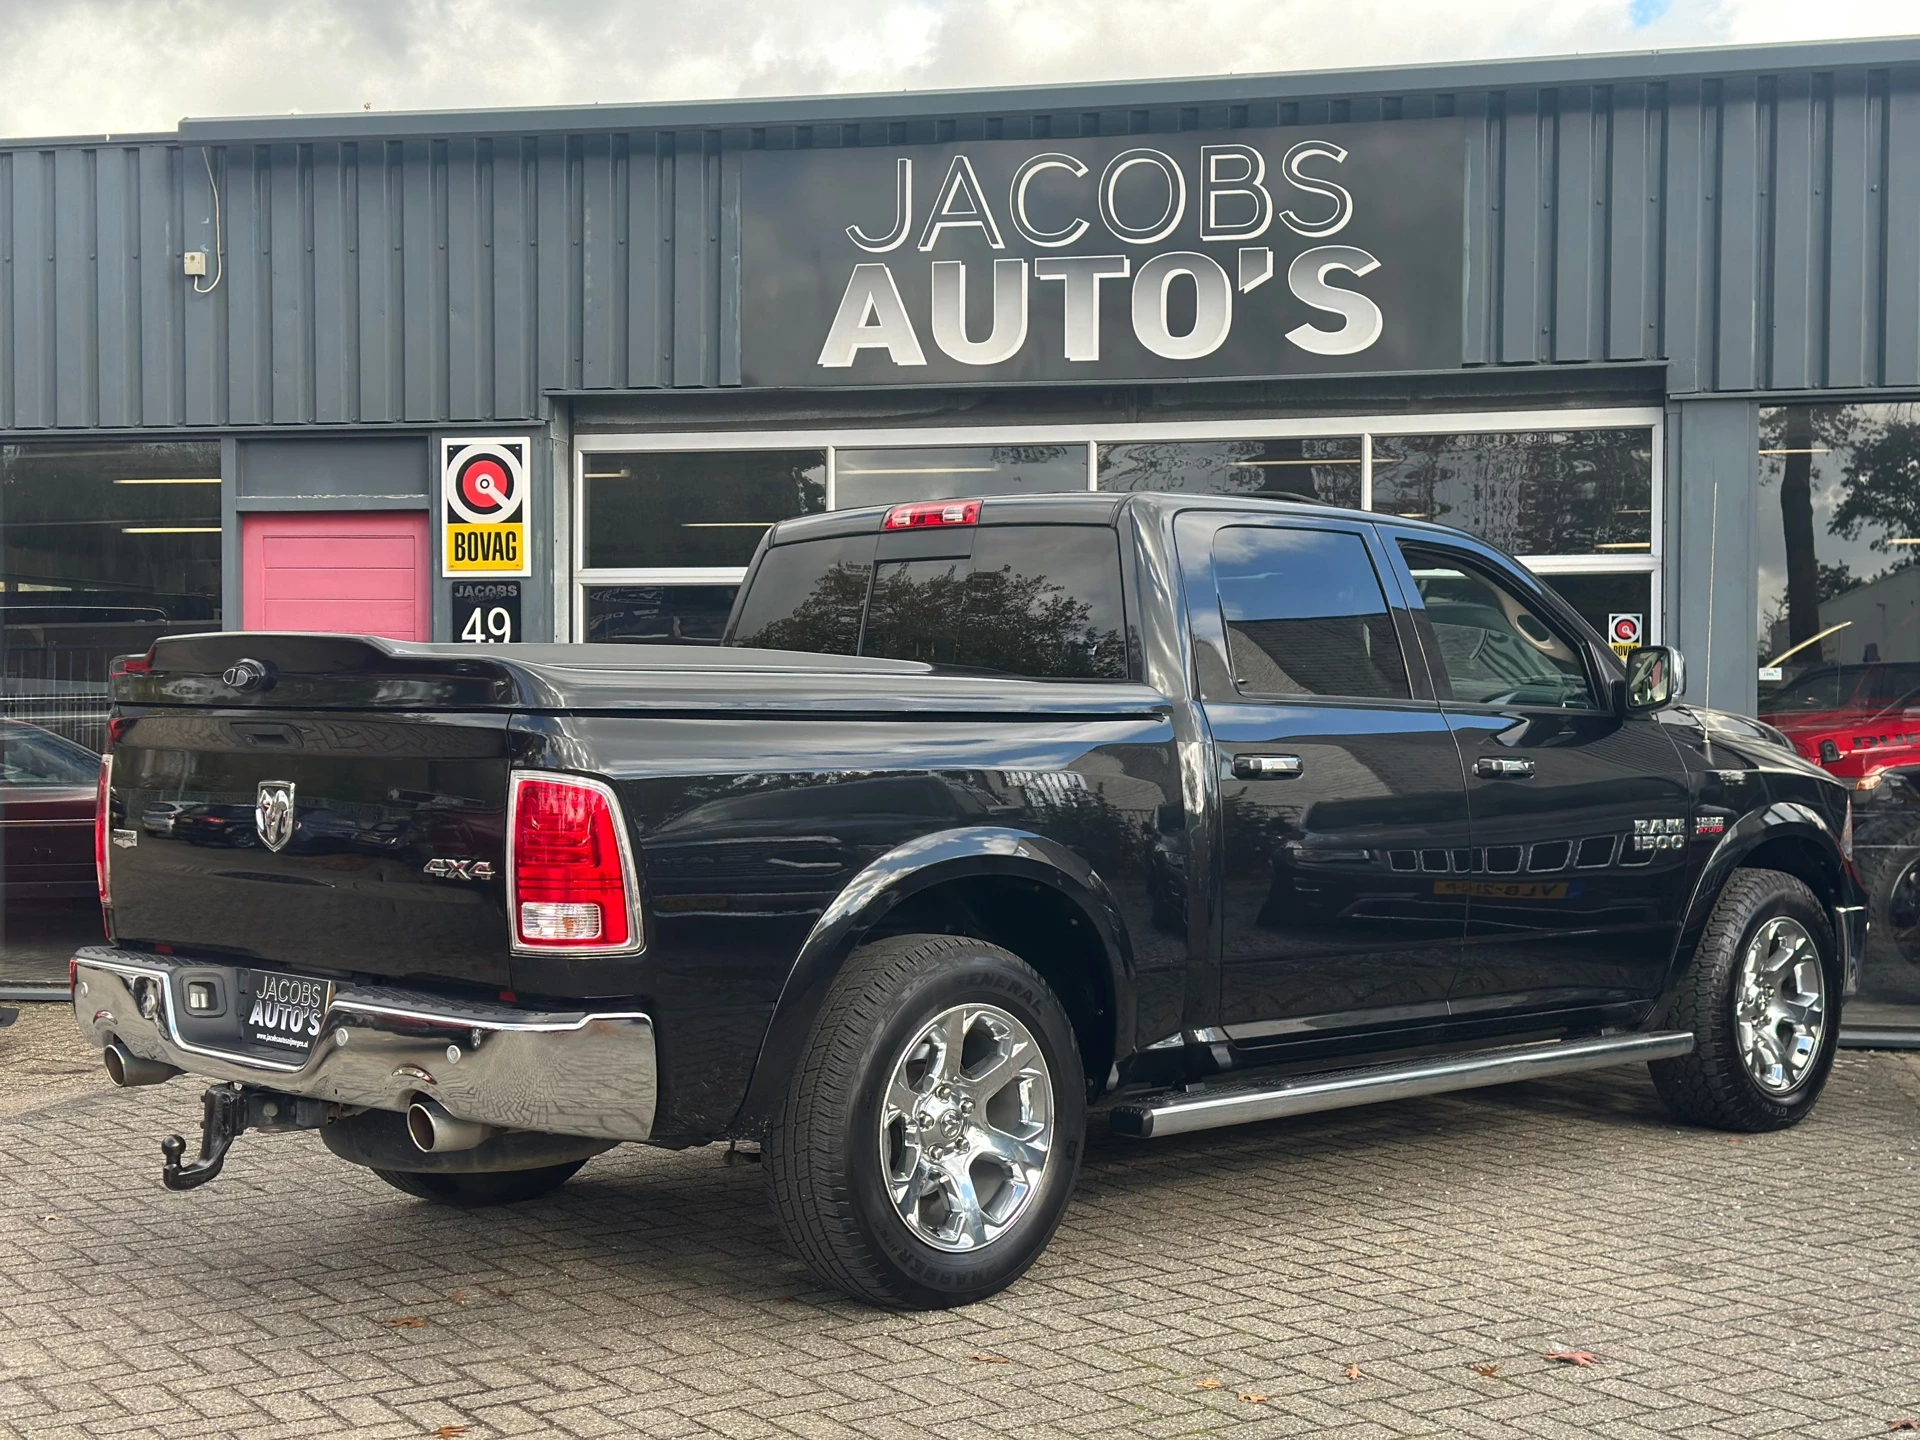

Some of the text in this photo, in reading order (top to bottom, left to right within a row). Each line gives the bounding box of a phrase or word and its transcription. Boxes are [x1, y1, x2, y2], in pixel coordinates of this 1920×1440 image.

[845, 140, 1353, 253] JACOBS
[817, 244, 1383, 368] AUTO'S
[454, 530, 517, 562] BOVAG
[454, 584, 518, 598] JACOBS
[461, 606, 512, 643] 49
[1634, 818, 1685, 834] RAM
[1634, 834, 1685, 851] 1500
[255, 975, 321, 1008] JACOBS
[248, 999, 322, 1036] AUTO'S
